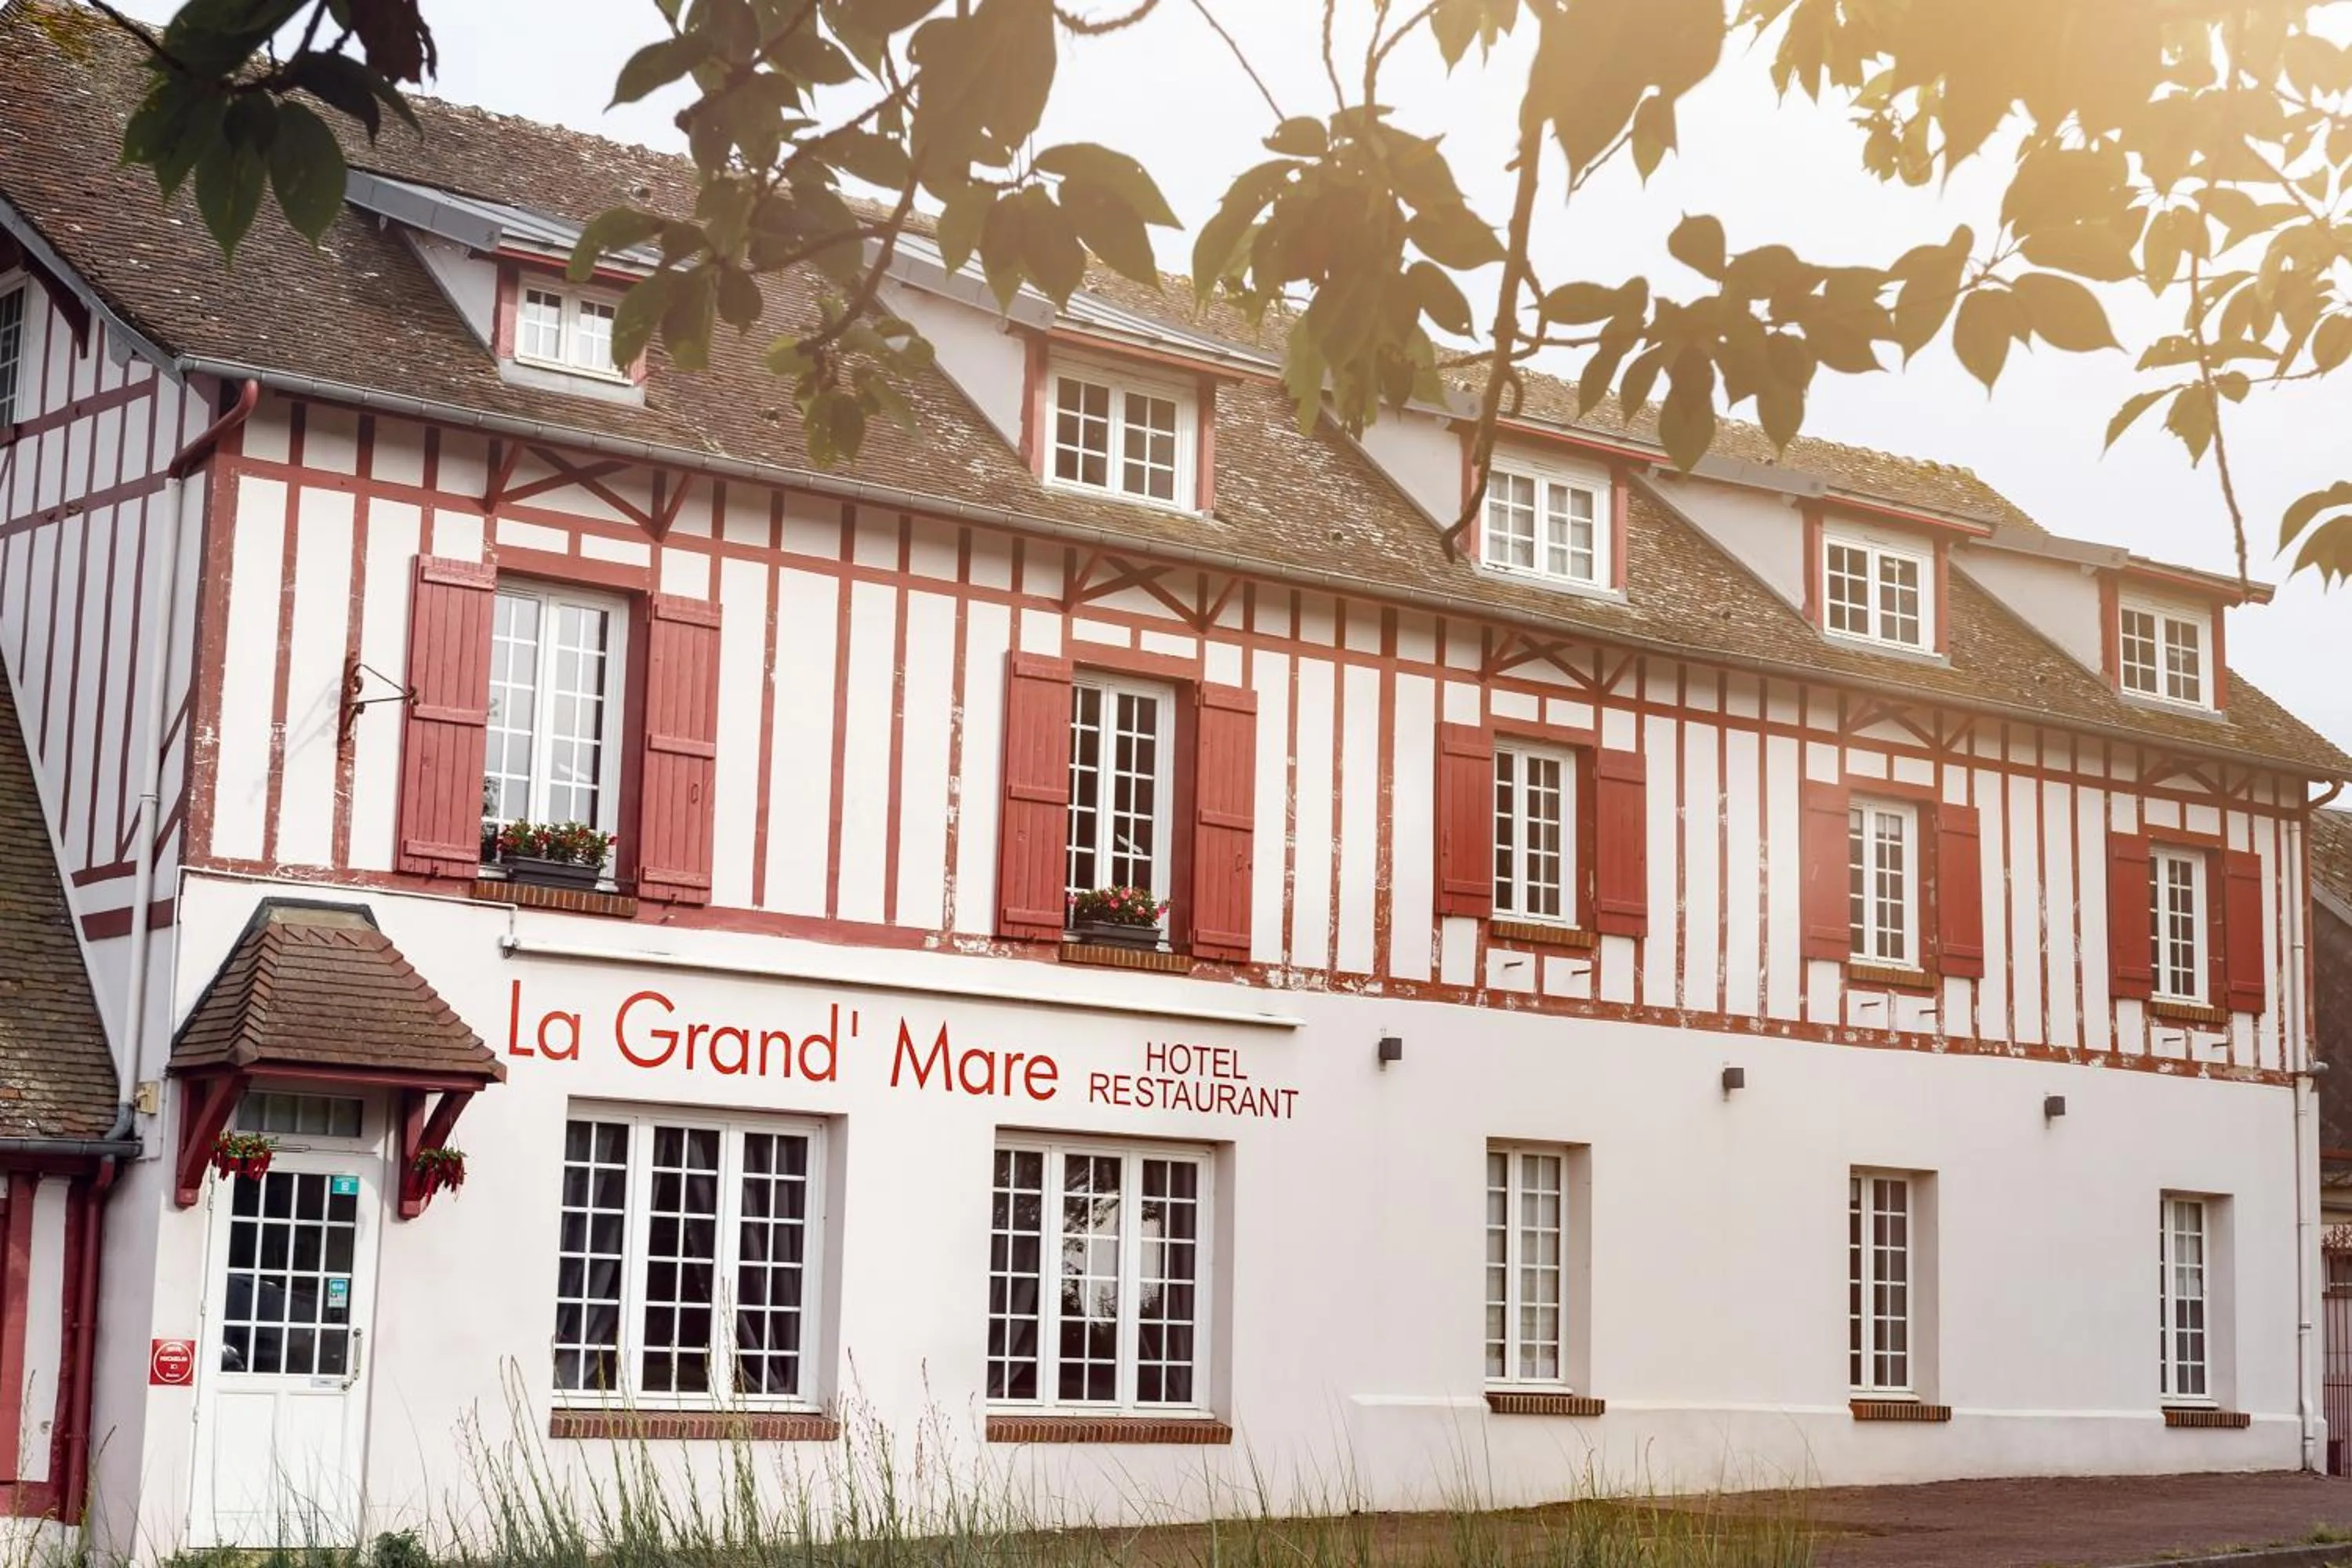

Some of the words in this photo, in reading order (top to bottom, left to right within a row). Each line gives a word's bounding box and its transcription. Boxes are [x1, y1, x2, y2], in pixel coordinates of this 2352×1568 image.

[509, 979, 582, 1061] La
[614, 991, 858, 1082] Grand'
[890, 1017, 1059, 1102] Mare
[1146, 1042, 1248, 1080] HOTEL
[1089, 1073, 1299, 1119] RESTAURANT
